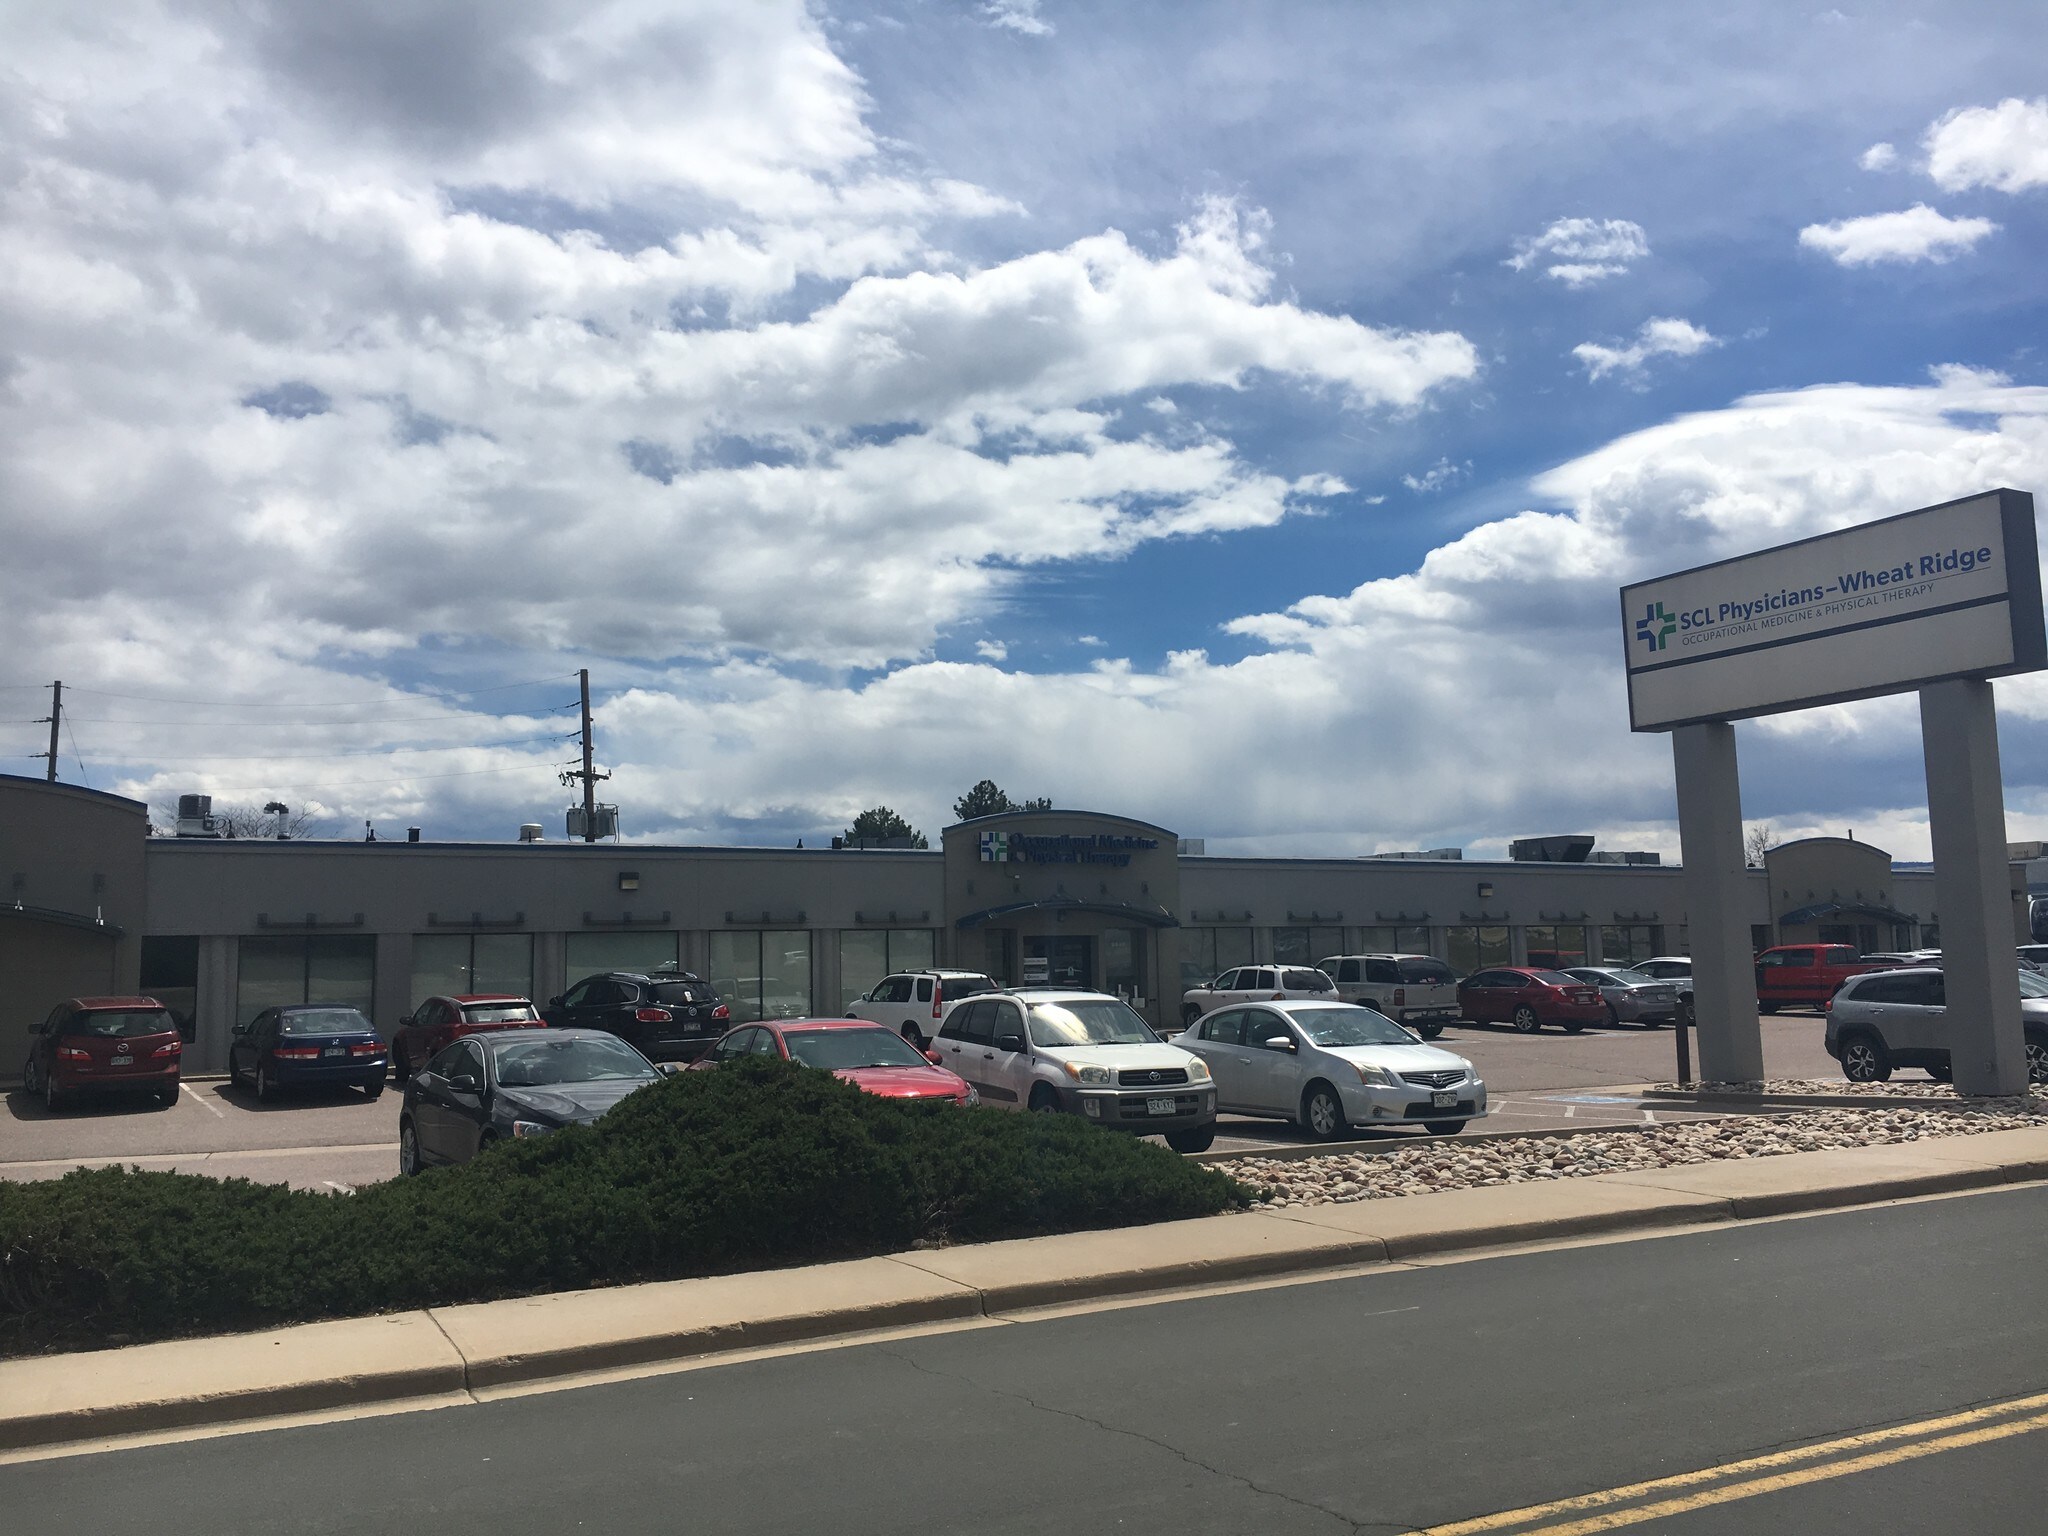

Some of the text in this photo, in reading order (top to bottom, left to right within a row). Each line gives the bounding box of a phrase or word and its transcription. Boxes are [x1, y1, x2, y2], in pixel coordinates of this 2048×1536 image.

[1680, 607, 1715, 630] SCL
[1920, 546, 1992, 576] Ridge
[1682, 582, 1935, 646] OCCUPATIONAL MEDICINE & PHYSICAL THERAPY
[1009, 832, 1159, 849] Occupational Medicine
